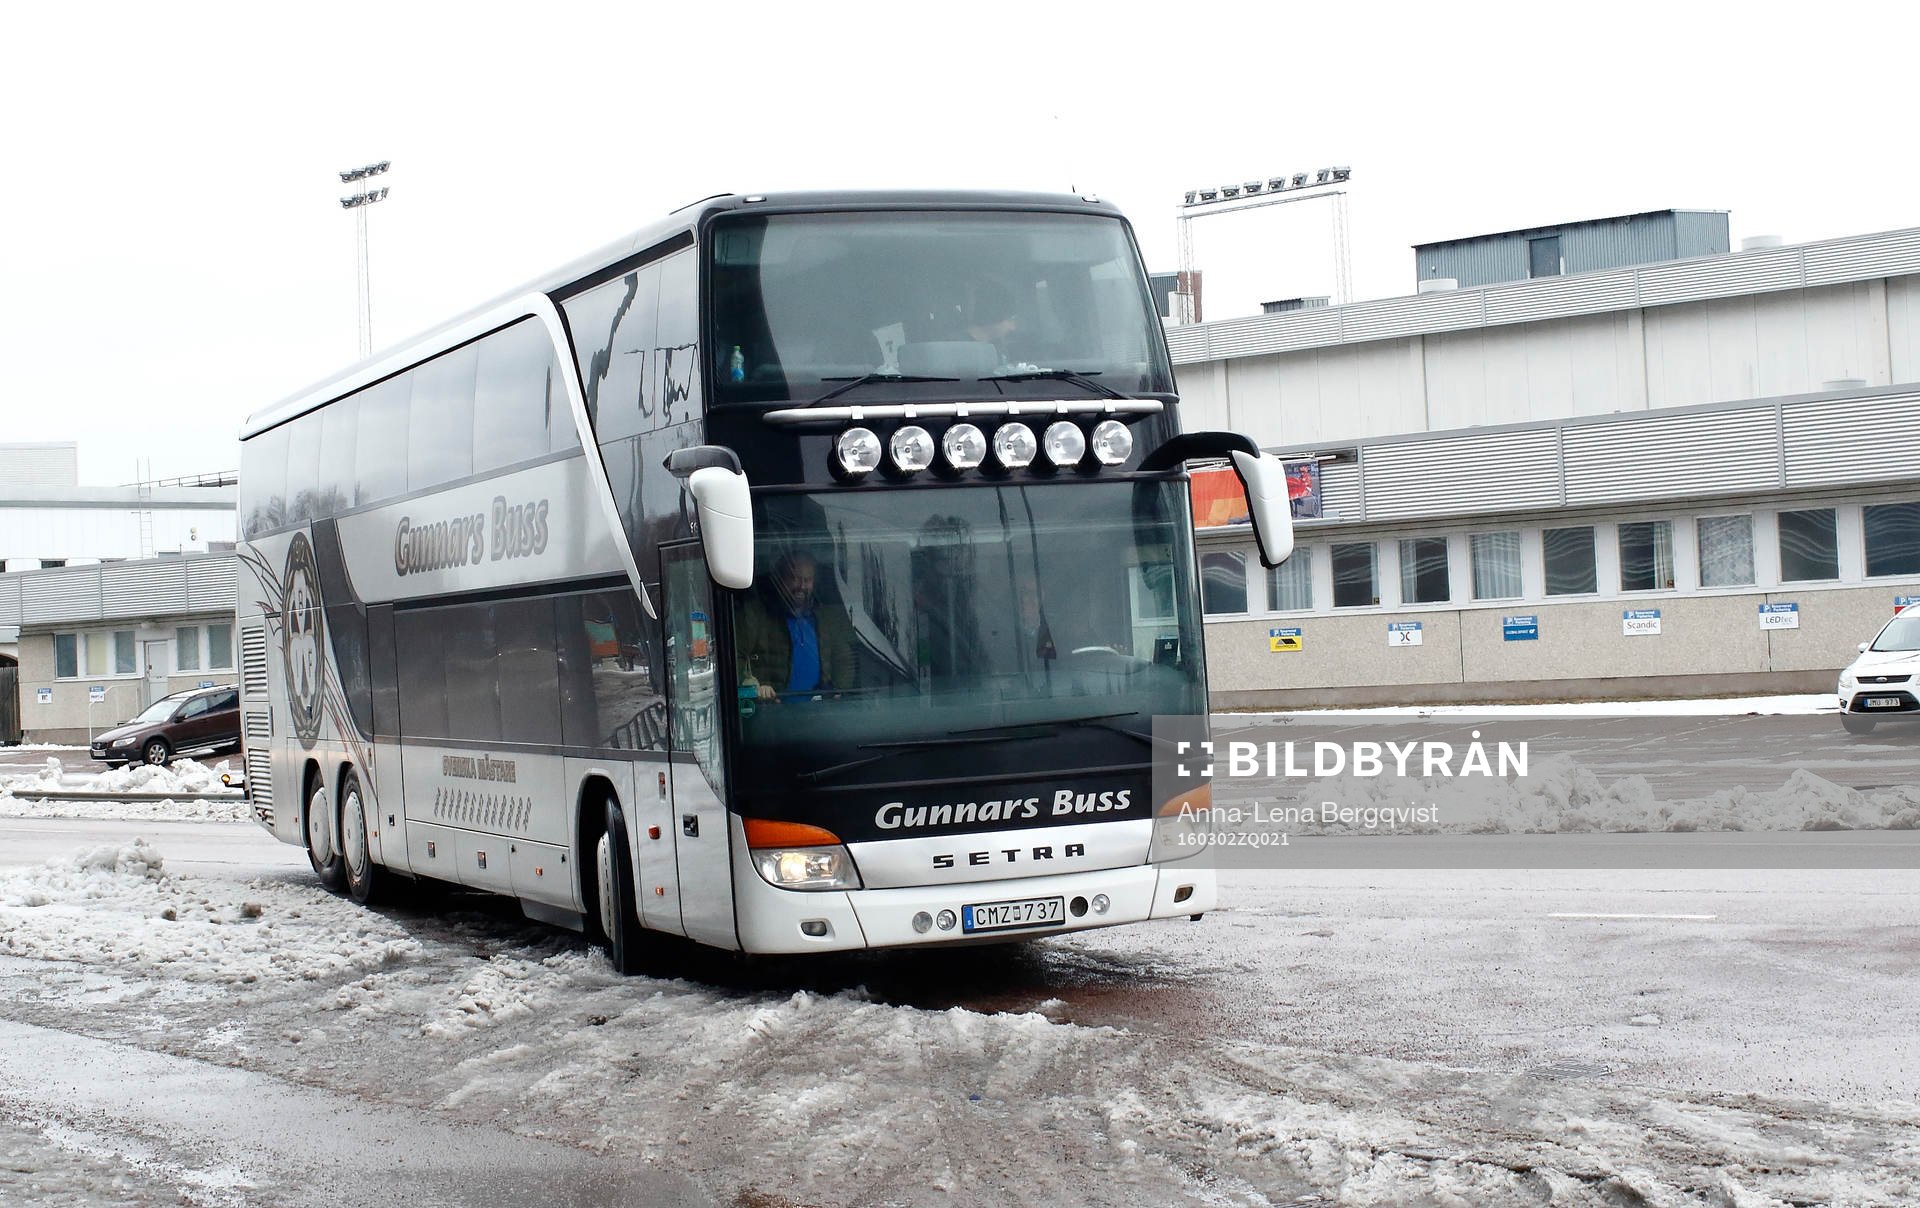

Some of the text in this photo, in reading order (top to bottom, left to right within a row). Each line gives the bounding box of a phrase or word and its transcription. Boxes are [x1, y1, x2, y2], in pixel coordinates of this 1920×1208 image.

[394, 495, 549, 577] Gunnars Buss
[1626, 617, 1657, 629] Scandic
[875, 789, 1132, 830] Gunnars Buss
[932, 843, 1085, 869] SETRA
[976, 901, 1058, 925] CMZ 737
